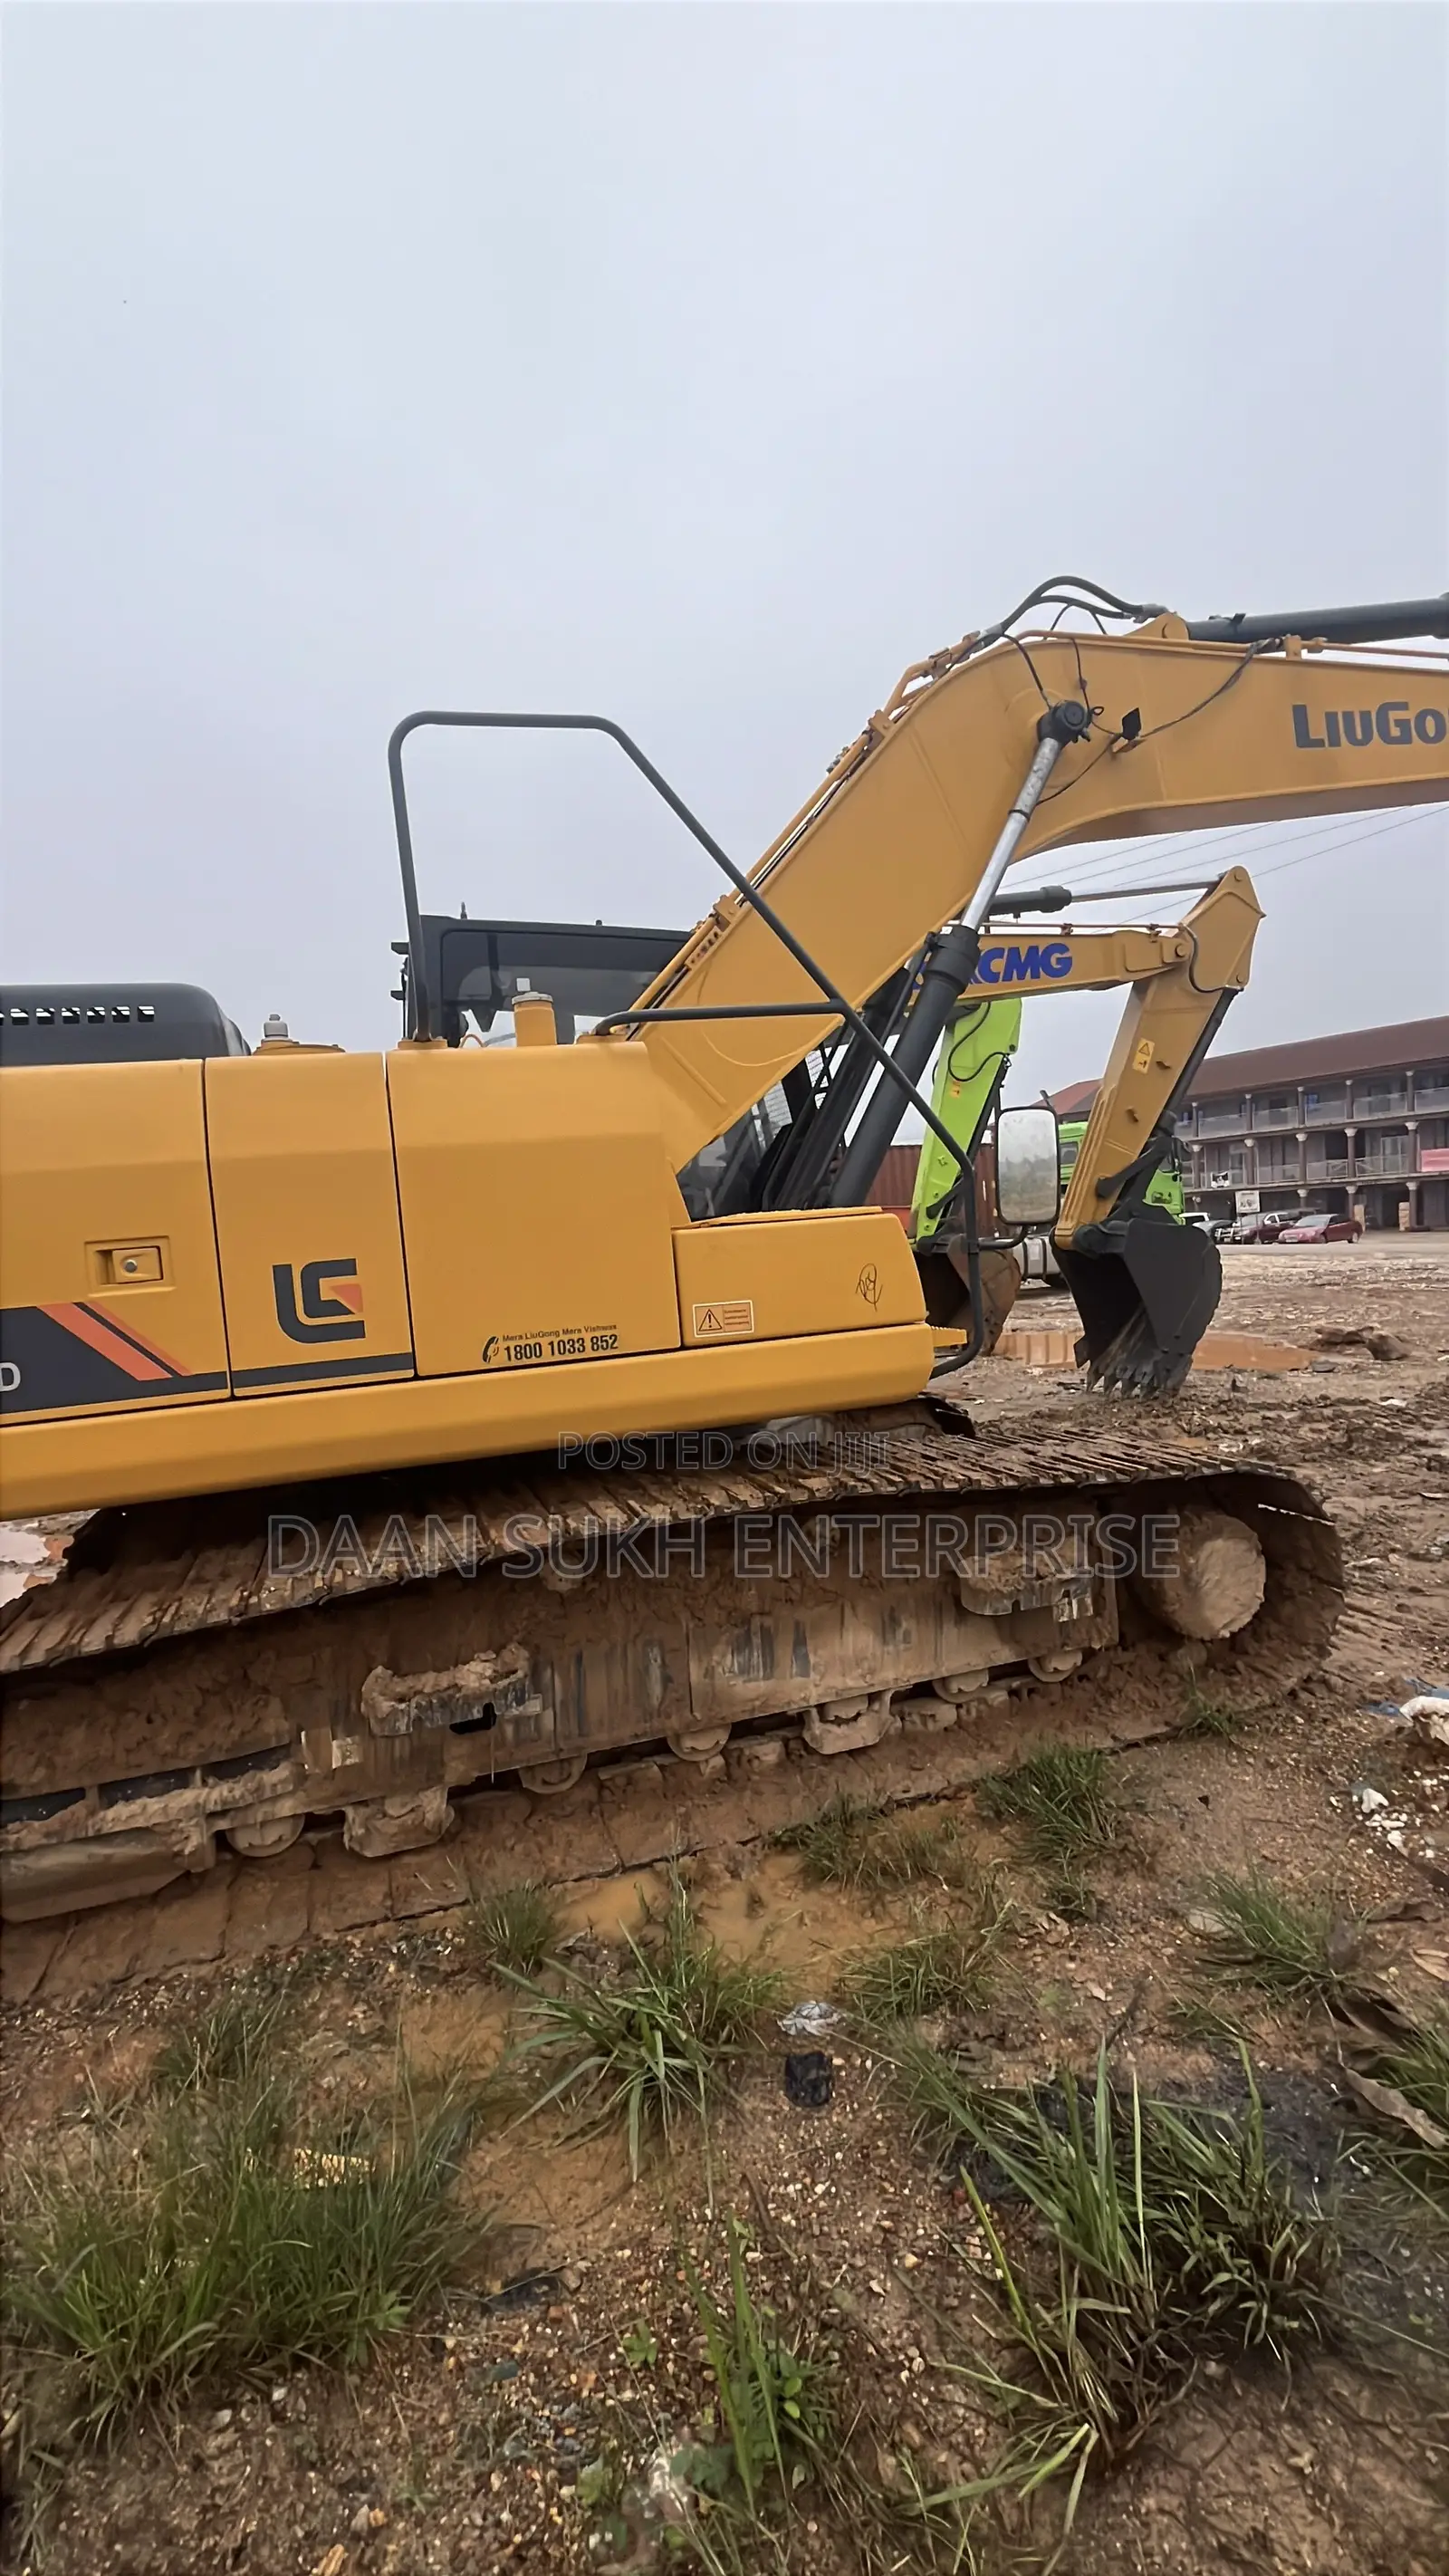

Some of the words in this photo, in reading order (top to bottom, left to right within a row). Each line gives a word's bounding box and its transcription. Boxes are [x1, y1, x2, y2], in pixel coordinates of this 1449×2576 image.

[1292, 701, 1449, 748] LiuGo
[970, 943, 1073, 985] CMG
[504, 1342, 543, 1361] 1800
[547, 1337, 586, 1356] 1033
[590, 1333, 619, 1351] 852
[525, 1330, 560, 1340] LiuGong
[561, 1328, 582, 1336] Mera
